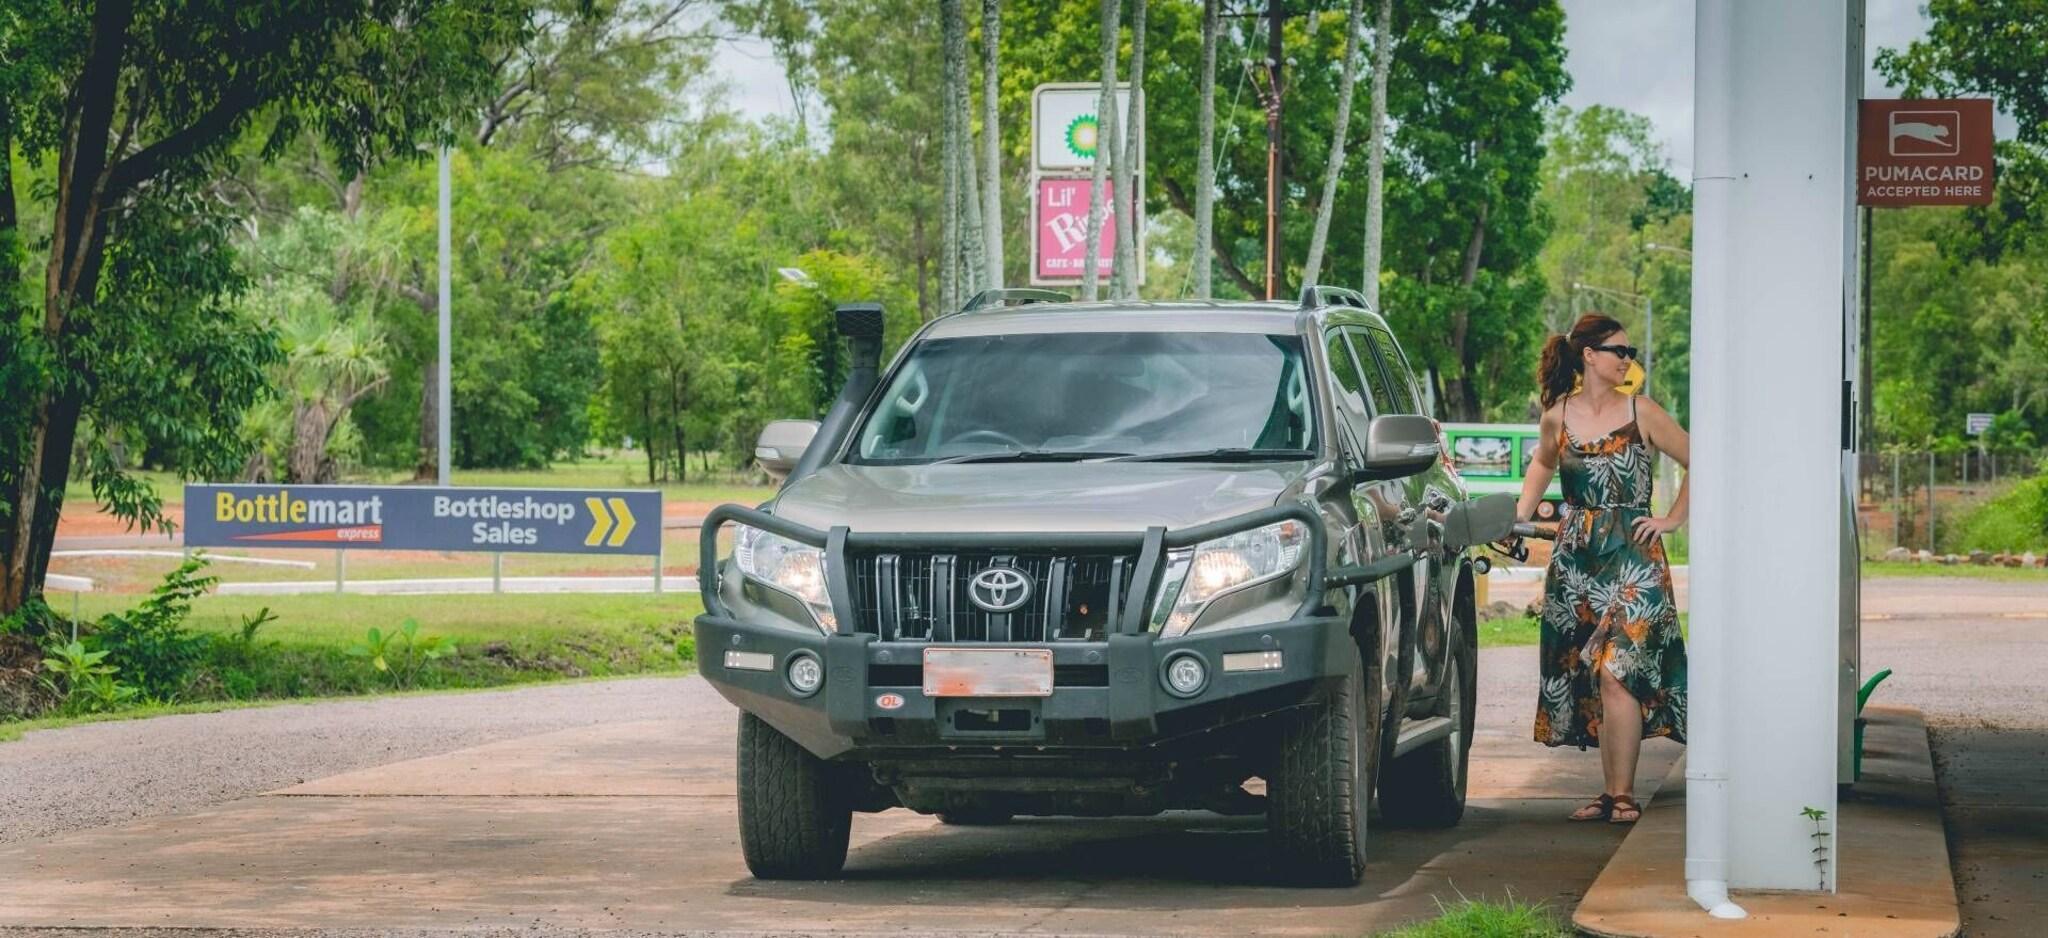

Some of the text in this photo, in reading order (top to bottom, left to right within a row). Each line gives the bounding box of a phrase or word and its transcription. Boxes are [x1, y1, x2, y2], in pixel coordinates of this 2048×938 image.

[1865, 166, 1983, 181] PUMACARD
[1047, 187, 1075, 207] Lil'
[1867, 186, 1981, 197] ACCEPTED HERE
[216, 491, 382, 524] Bottlemart
[434, 496, 575, 525] Bottleshop
[336, 528, 379, 542] express
[472, 522, 537, 545] Sales
